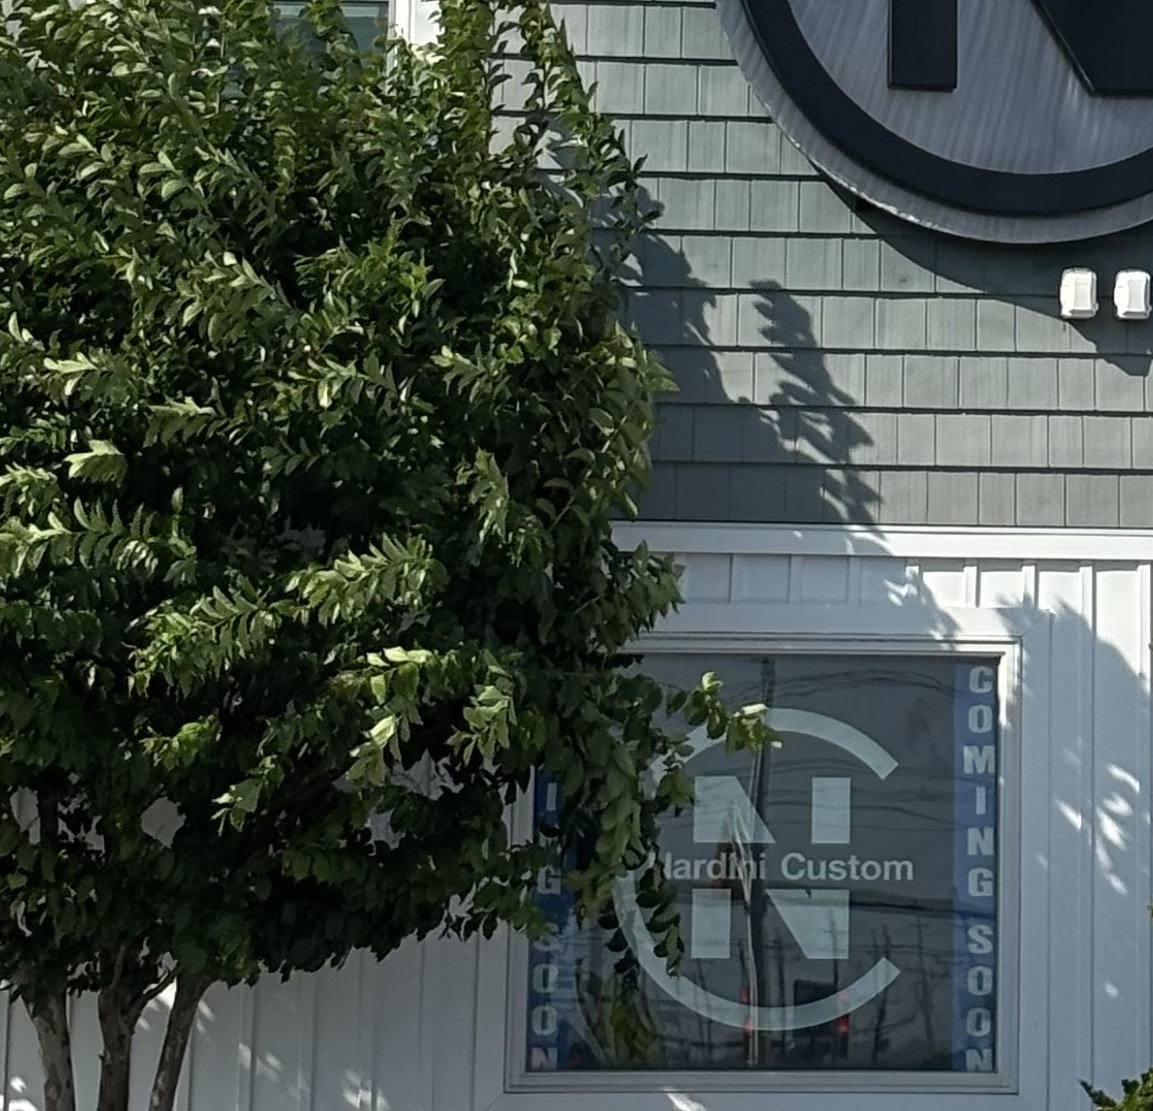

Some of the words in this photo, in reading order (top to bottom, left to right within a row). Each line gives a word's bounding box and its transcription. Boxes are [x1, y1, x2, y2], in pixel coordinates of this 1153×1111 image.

[963, 666, 996, 897] COMING
[781, 851, 914, 881] Custom
[965, 924, 994, 1072] SOON
